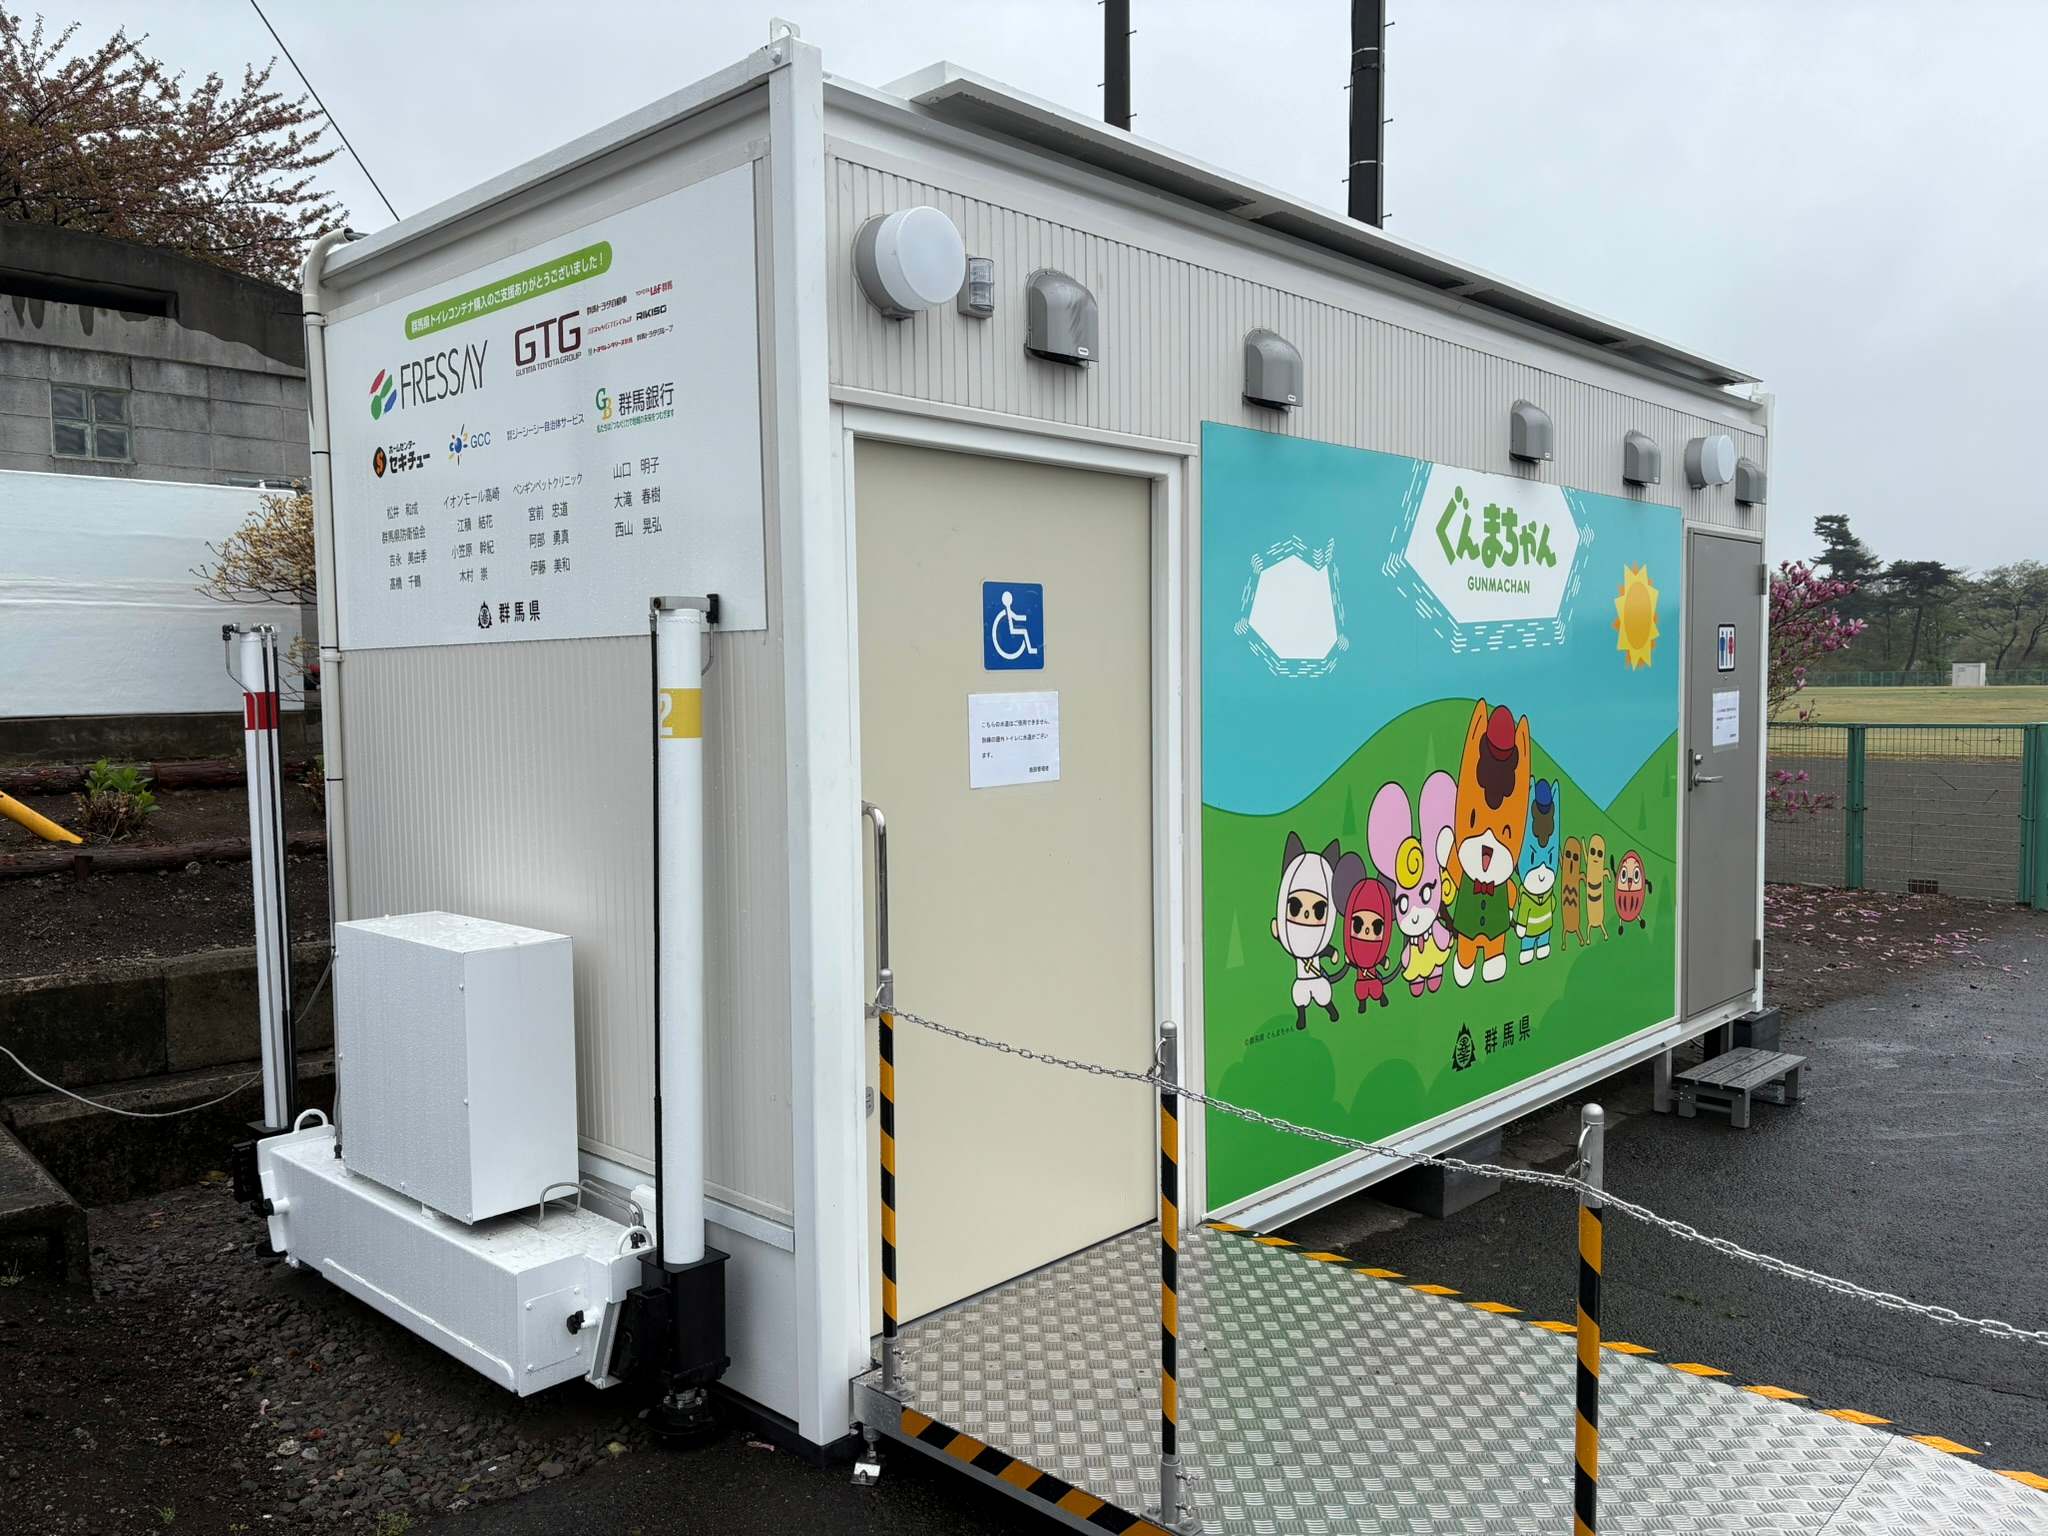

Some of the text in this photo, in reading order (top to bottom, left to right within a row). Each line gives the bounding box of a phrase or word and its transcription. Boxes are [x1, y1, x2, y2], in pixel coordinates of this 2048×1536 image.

[636, 304, 667, 320] RIKISO
[515, 310, 582, 367] GTG
[401, 340, 488, 410] FRESSAY
[618, 382, 675, 416] 群馬銀行
[470, 431, 491, 449] GCC
[389, 450, 431, 474] セキチュー
[613, 457, 659, 480] 山口 明子
[512, 472, 583, 496] ペンギンペットクリニック
[443, 486, 500, 510] イオンモール高崎
[528, 506, 544, 522] 宮前
[615, 520, 633, 537] 西山
[1435, 485, 1557, 569] ぐんまちゃん
[529, 532, 546, 549] 阿部
[458, 568, 474, 583] 木村
[553, 556, 571, 574] 美和
[1467, 576, 1530, 594] GUNMACHAN
[499, 600, 540, 624] 群馬県
[1484, 1014, 1532, 1055] 群馬県
